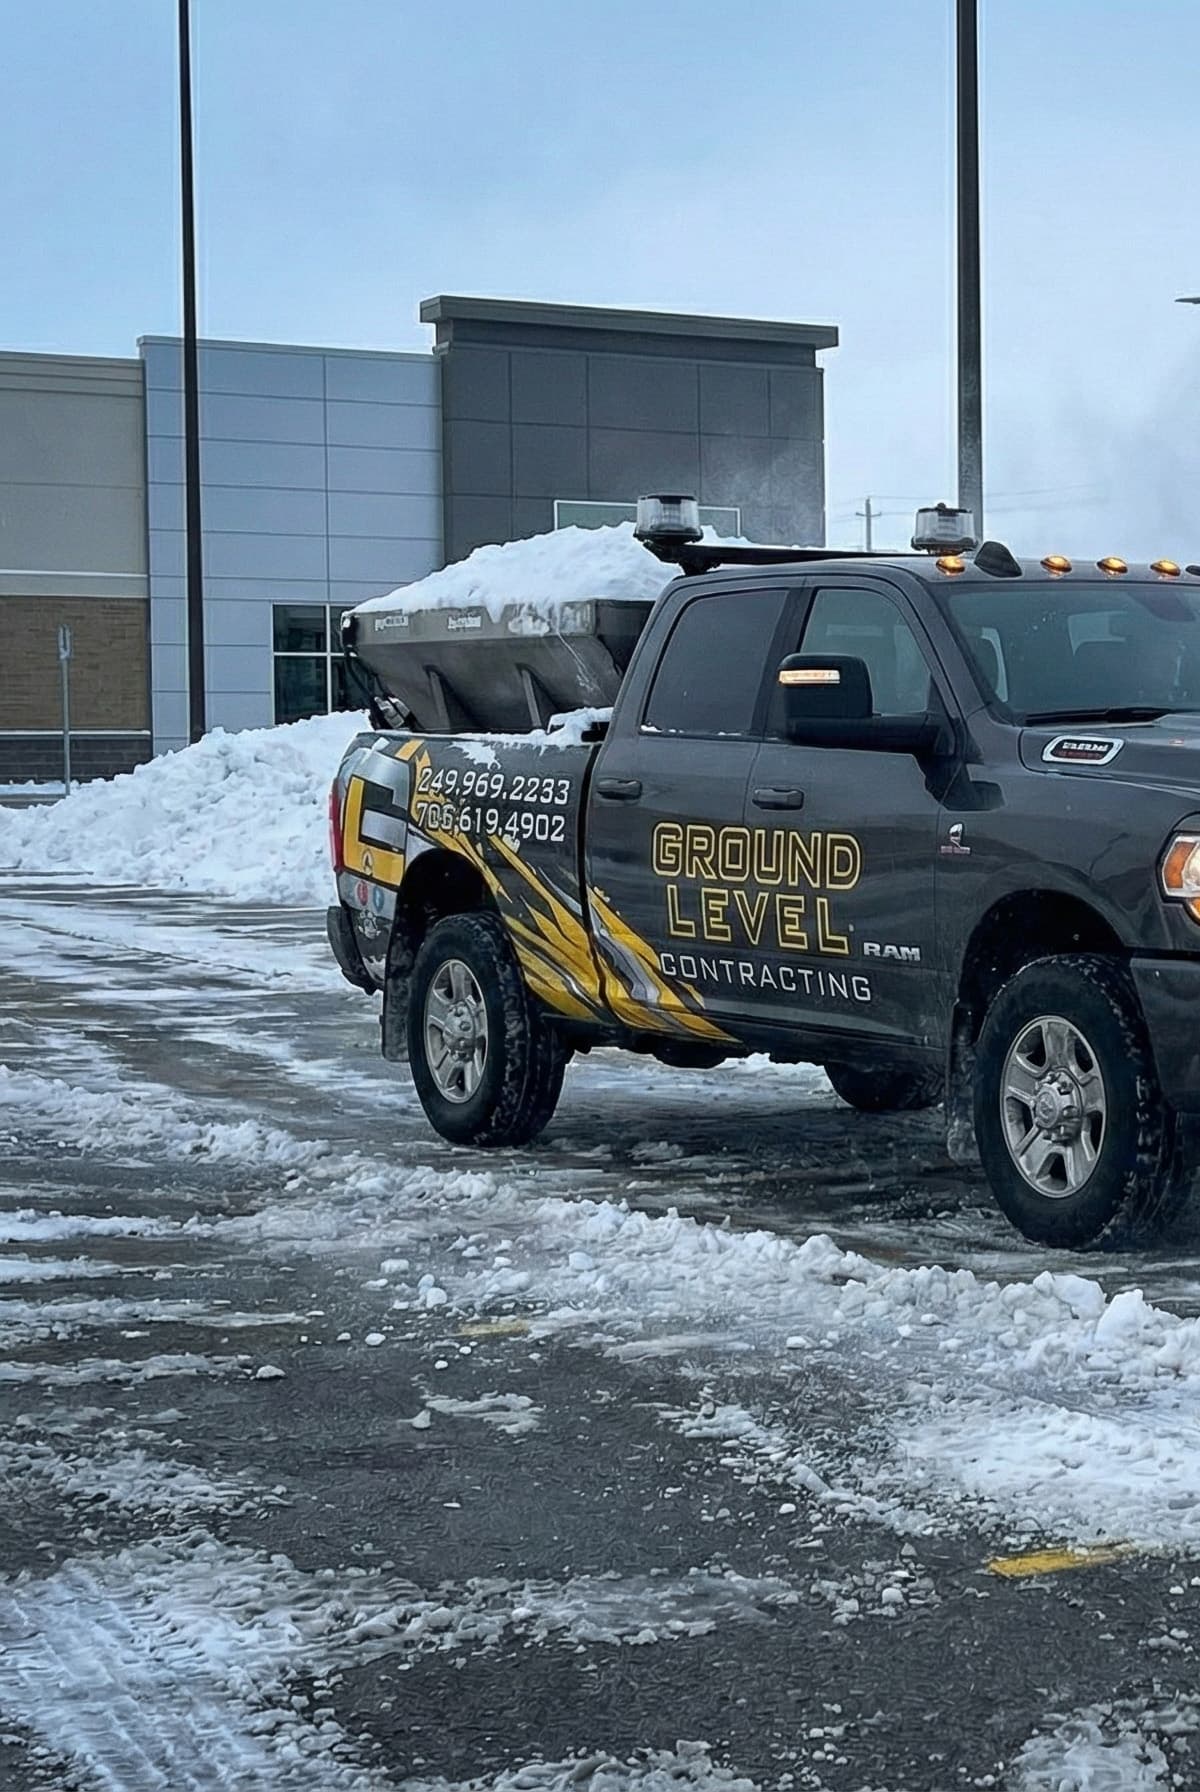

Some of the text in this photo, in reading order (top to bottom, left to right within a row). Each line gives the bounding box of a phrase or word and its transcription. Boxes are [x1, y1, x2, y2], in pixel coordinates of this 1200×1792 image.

[418, 767, 570, 805] 249.969.2233
[653, 822, 861, 890] GROUND
[666, 884, 850, 955] LEVEL
[863, 942, 921, 961] RAM
[660, 953, 872, 1002] CONTRACTING
